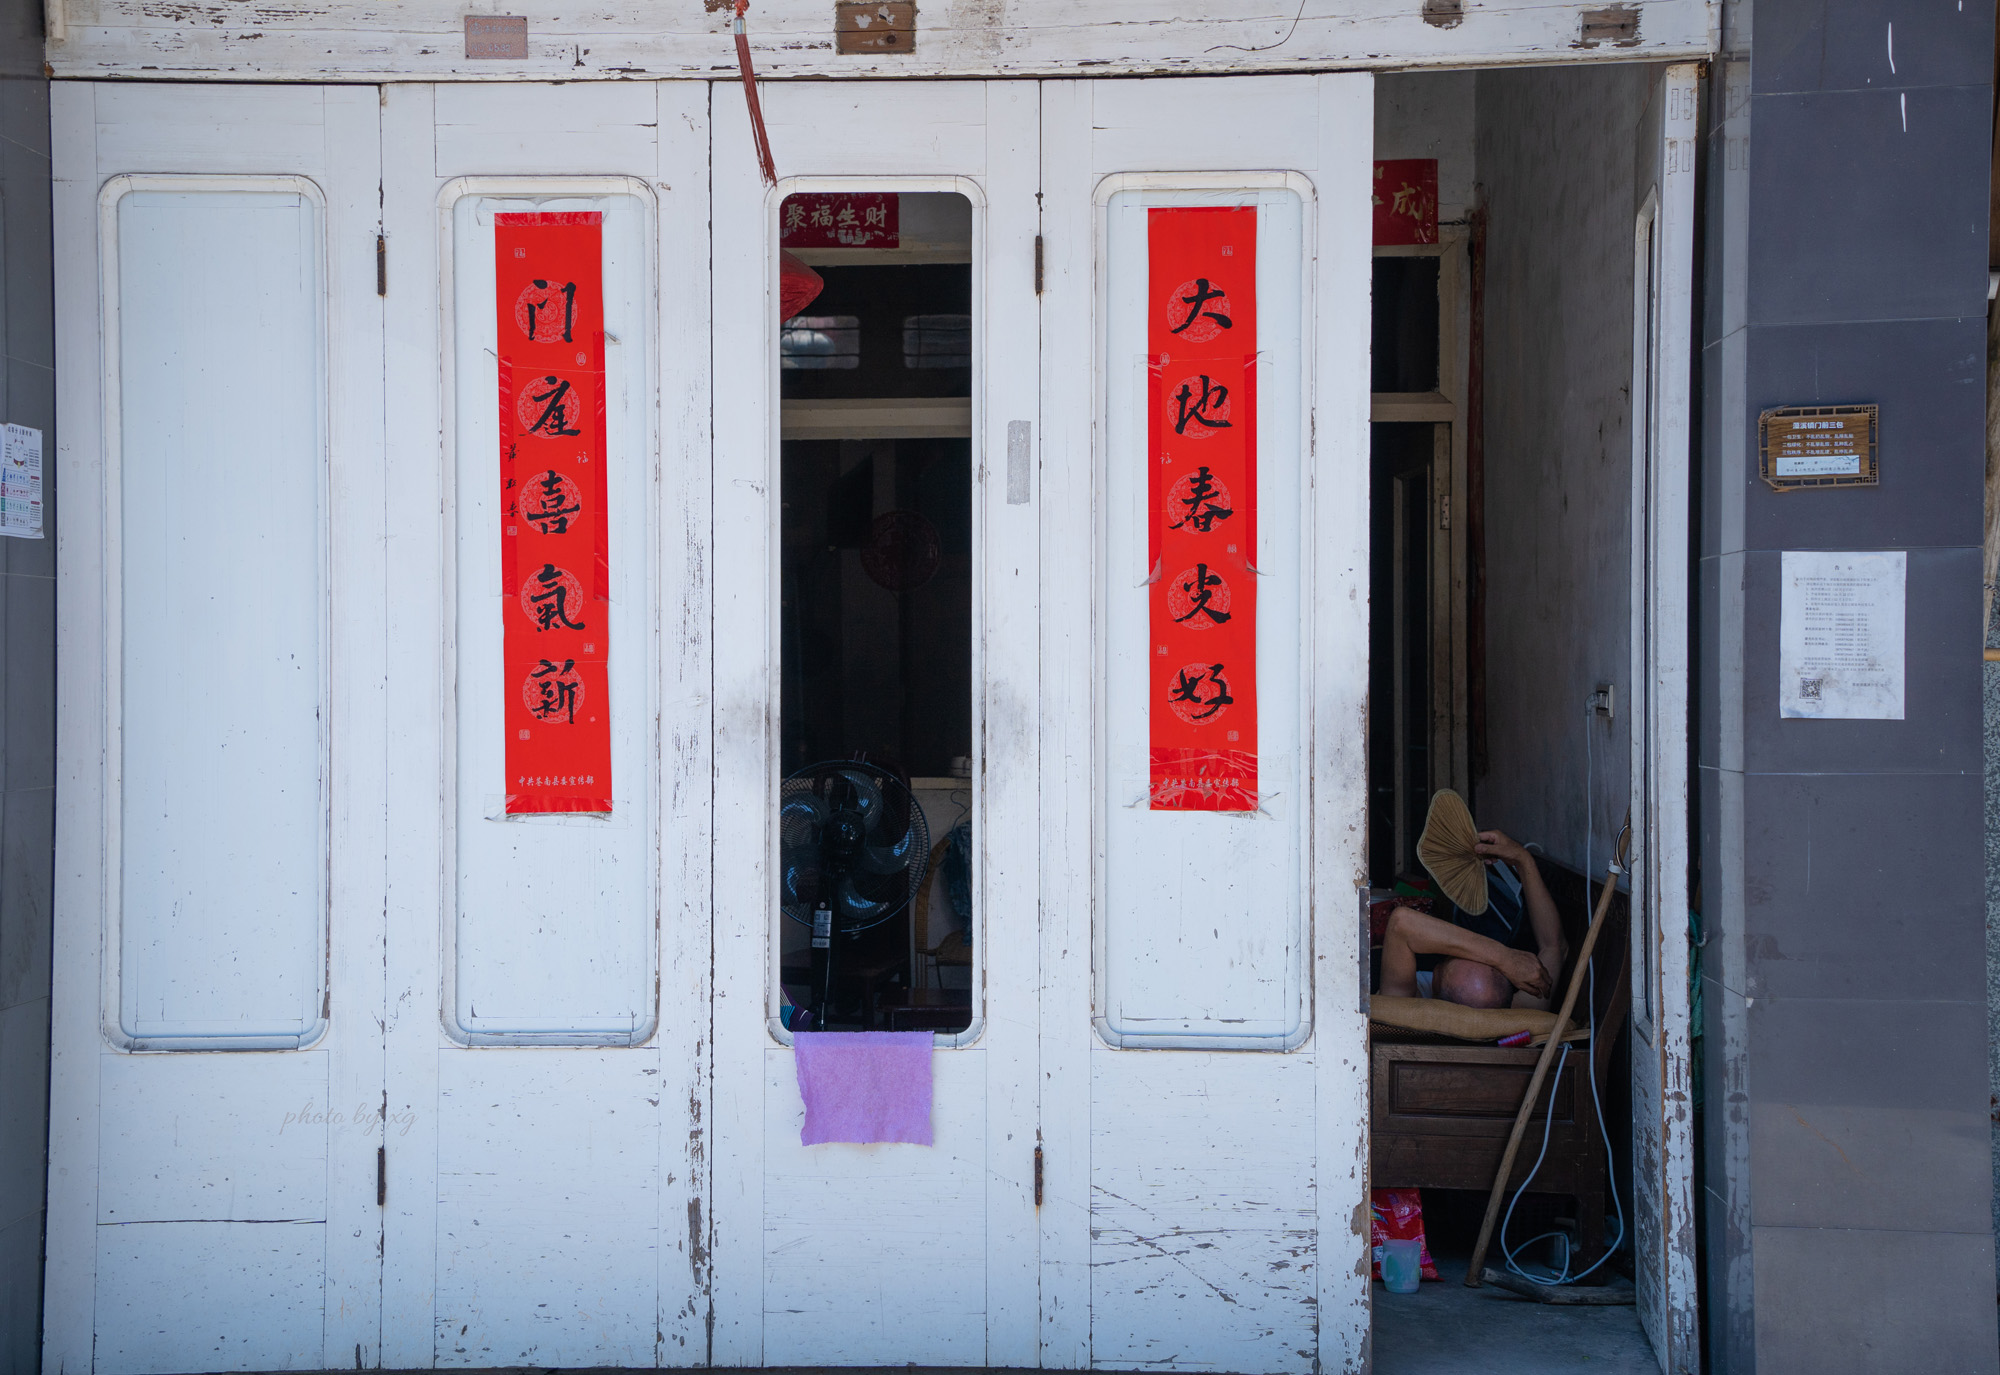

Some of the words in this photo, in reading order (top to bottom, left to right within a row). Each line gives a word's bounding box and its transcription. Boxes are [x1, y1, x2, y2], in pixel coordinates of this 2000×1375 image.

[785, 202, 888, 229] 聚福生财
[518, 775, 595, 787] 中共苍南县委宣传部
